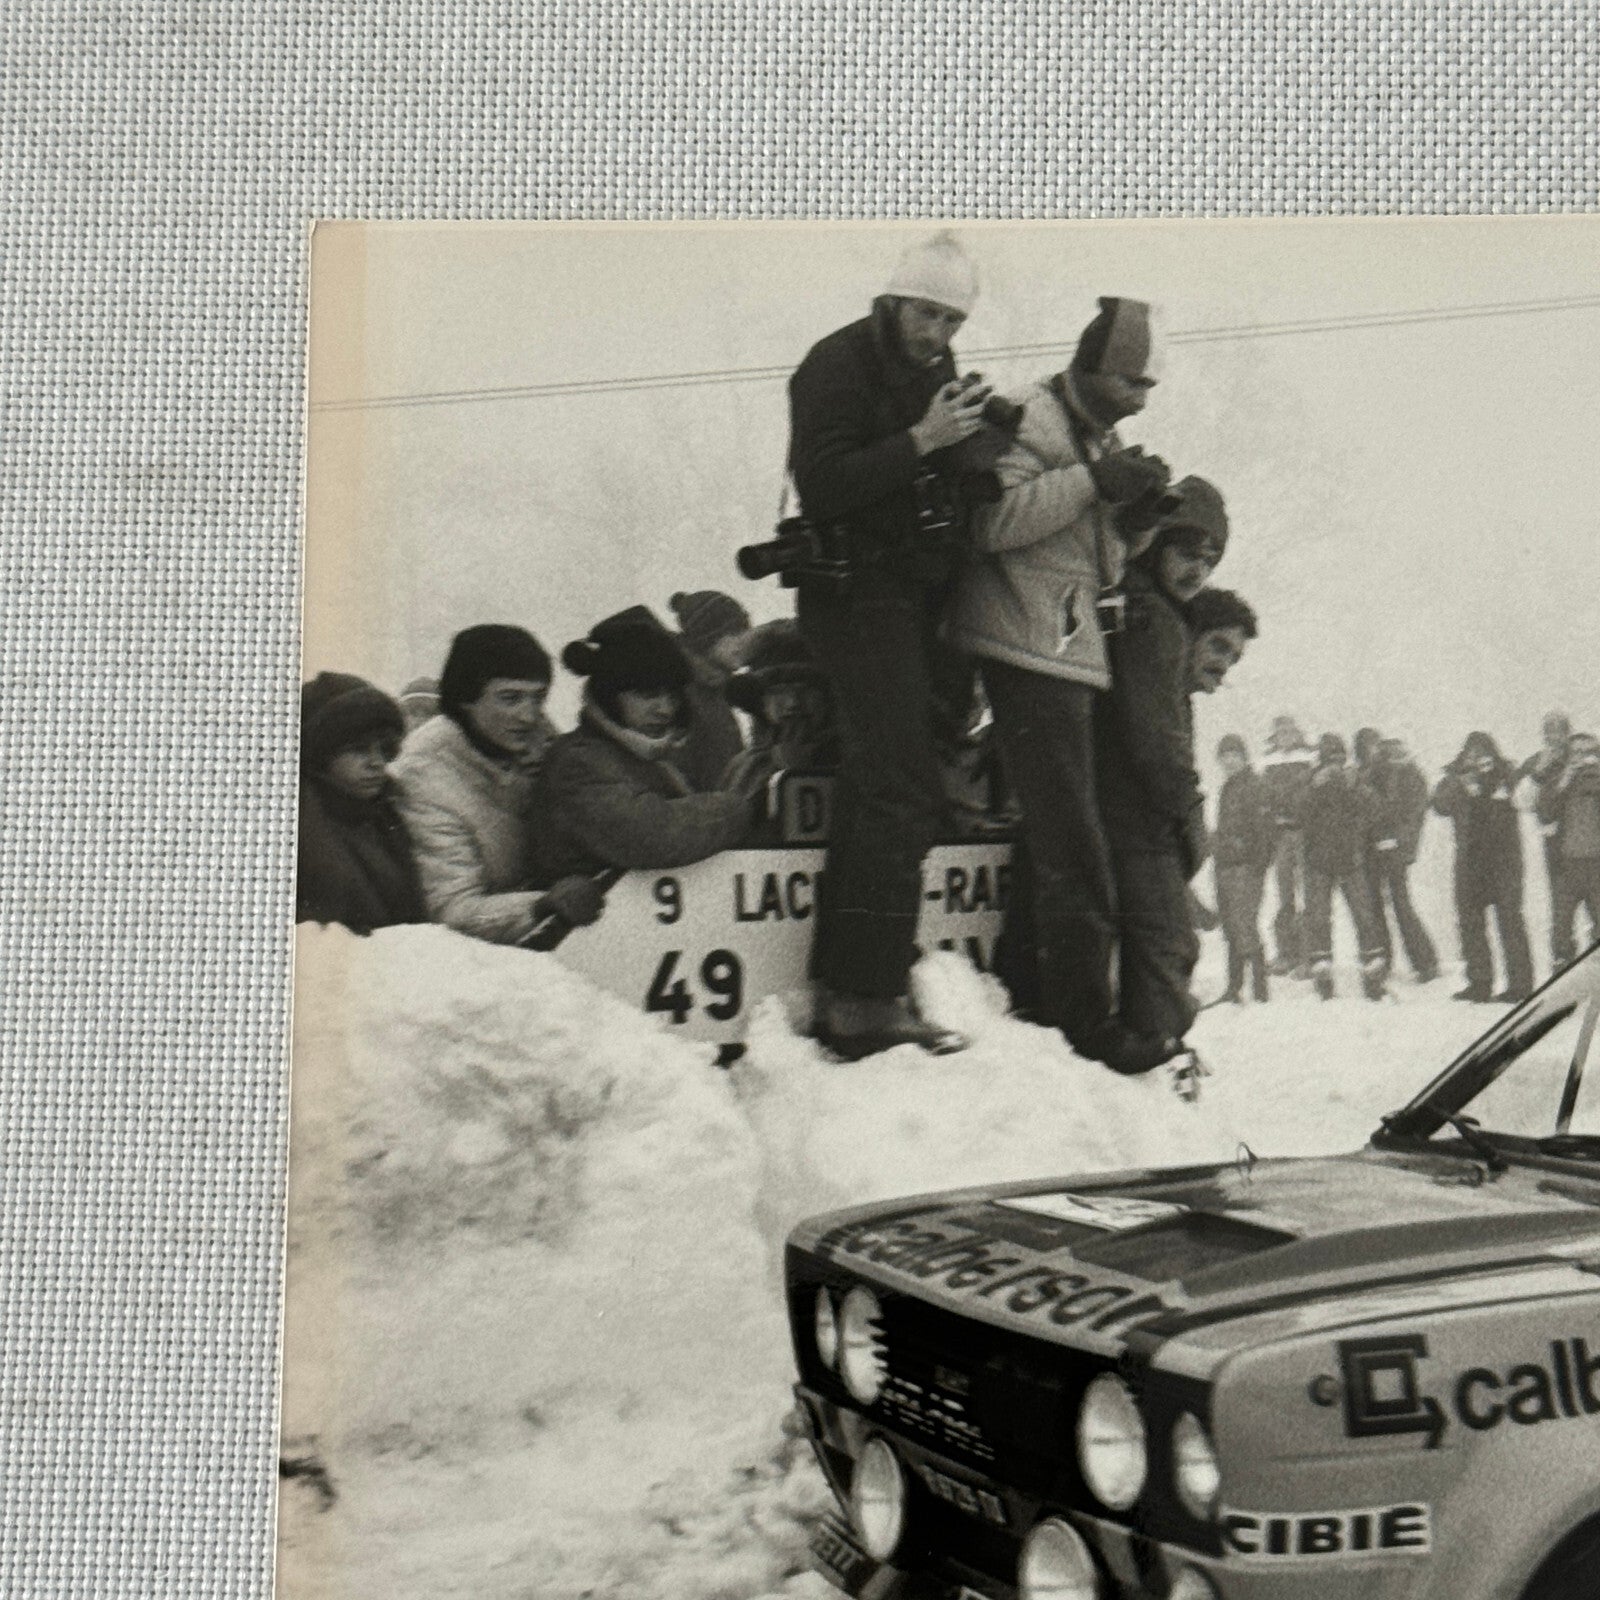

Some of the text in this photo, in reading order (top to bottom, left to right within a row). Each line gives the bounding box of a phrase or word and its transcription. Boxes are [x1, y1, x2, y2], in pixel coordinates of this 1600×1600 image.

[652, 876, 683, 924] 9
[644, 949, 742, 1025] 49
[1222, 1506, 1426, 1555] CIBIE
